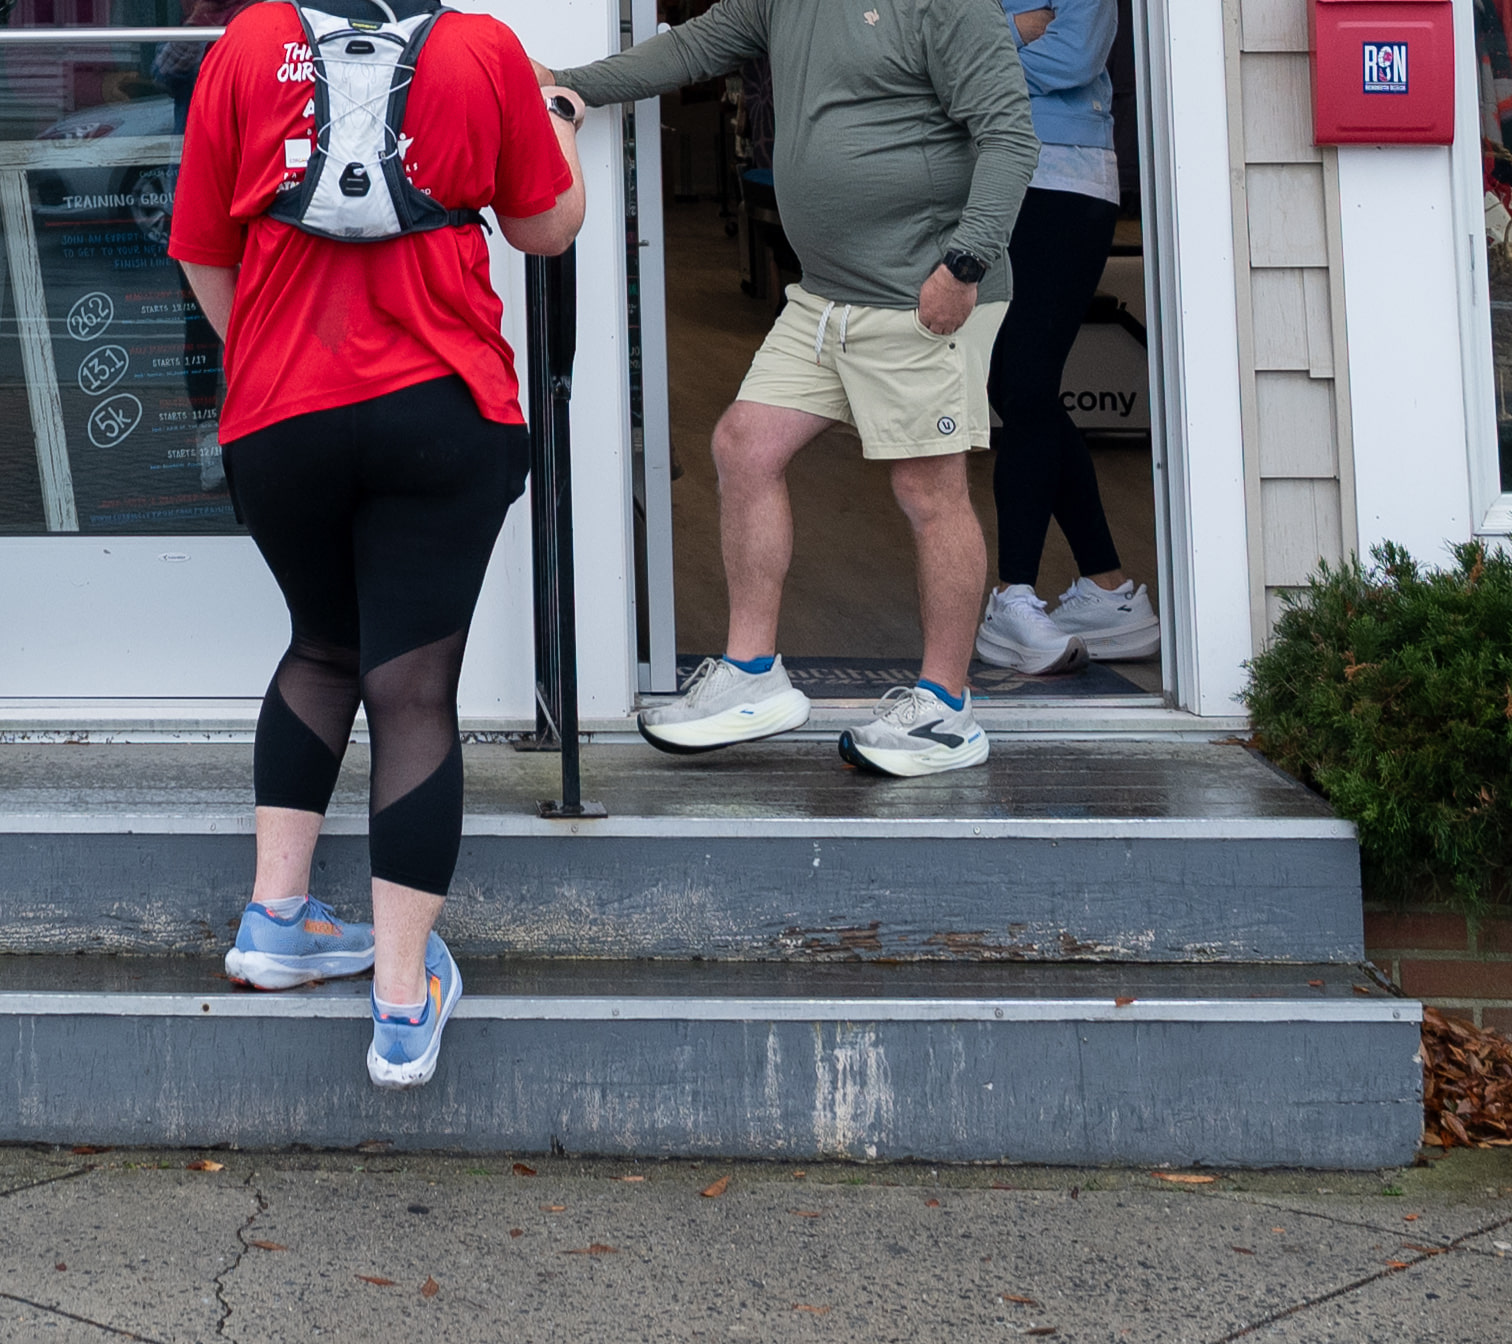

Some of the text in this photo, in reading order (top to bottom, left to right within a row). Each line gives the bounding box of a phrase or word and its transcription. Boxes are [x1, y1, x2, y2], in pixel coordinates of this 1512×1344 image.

[63, 193, 135, 209] TRAINING
[71, 296, 109, 336] 26.2
[82, 348, 124, 390] 13.1
